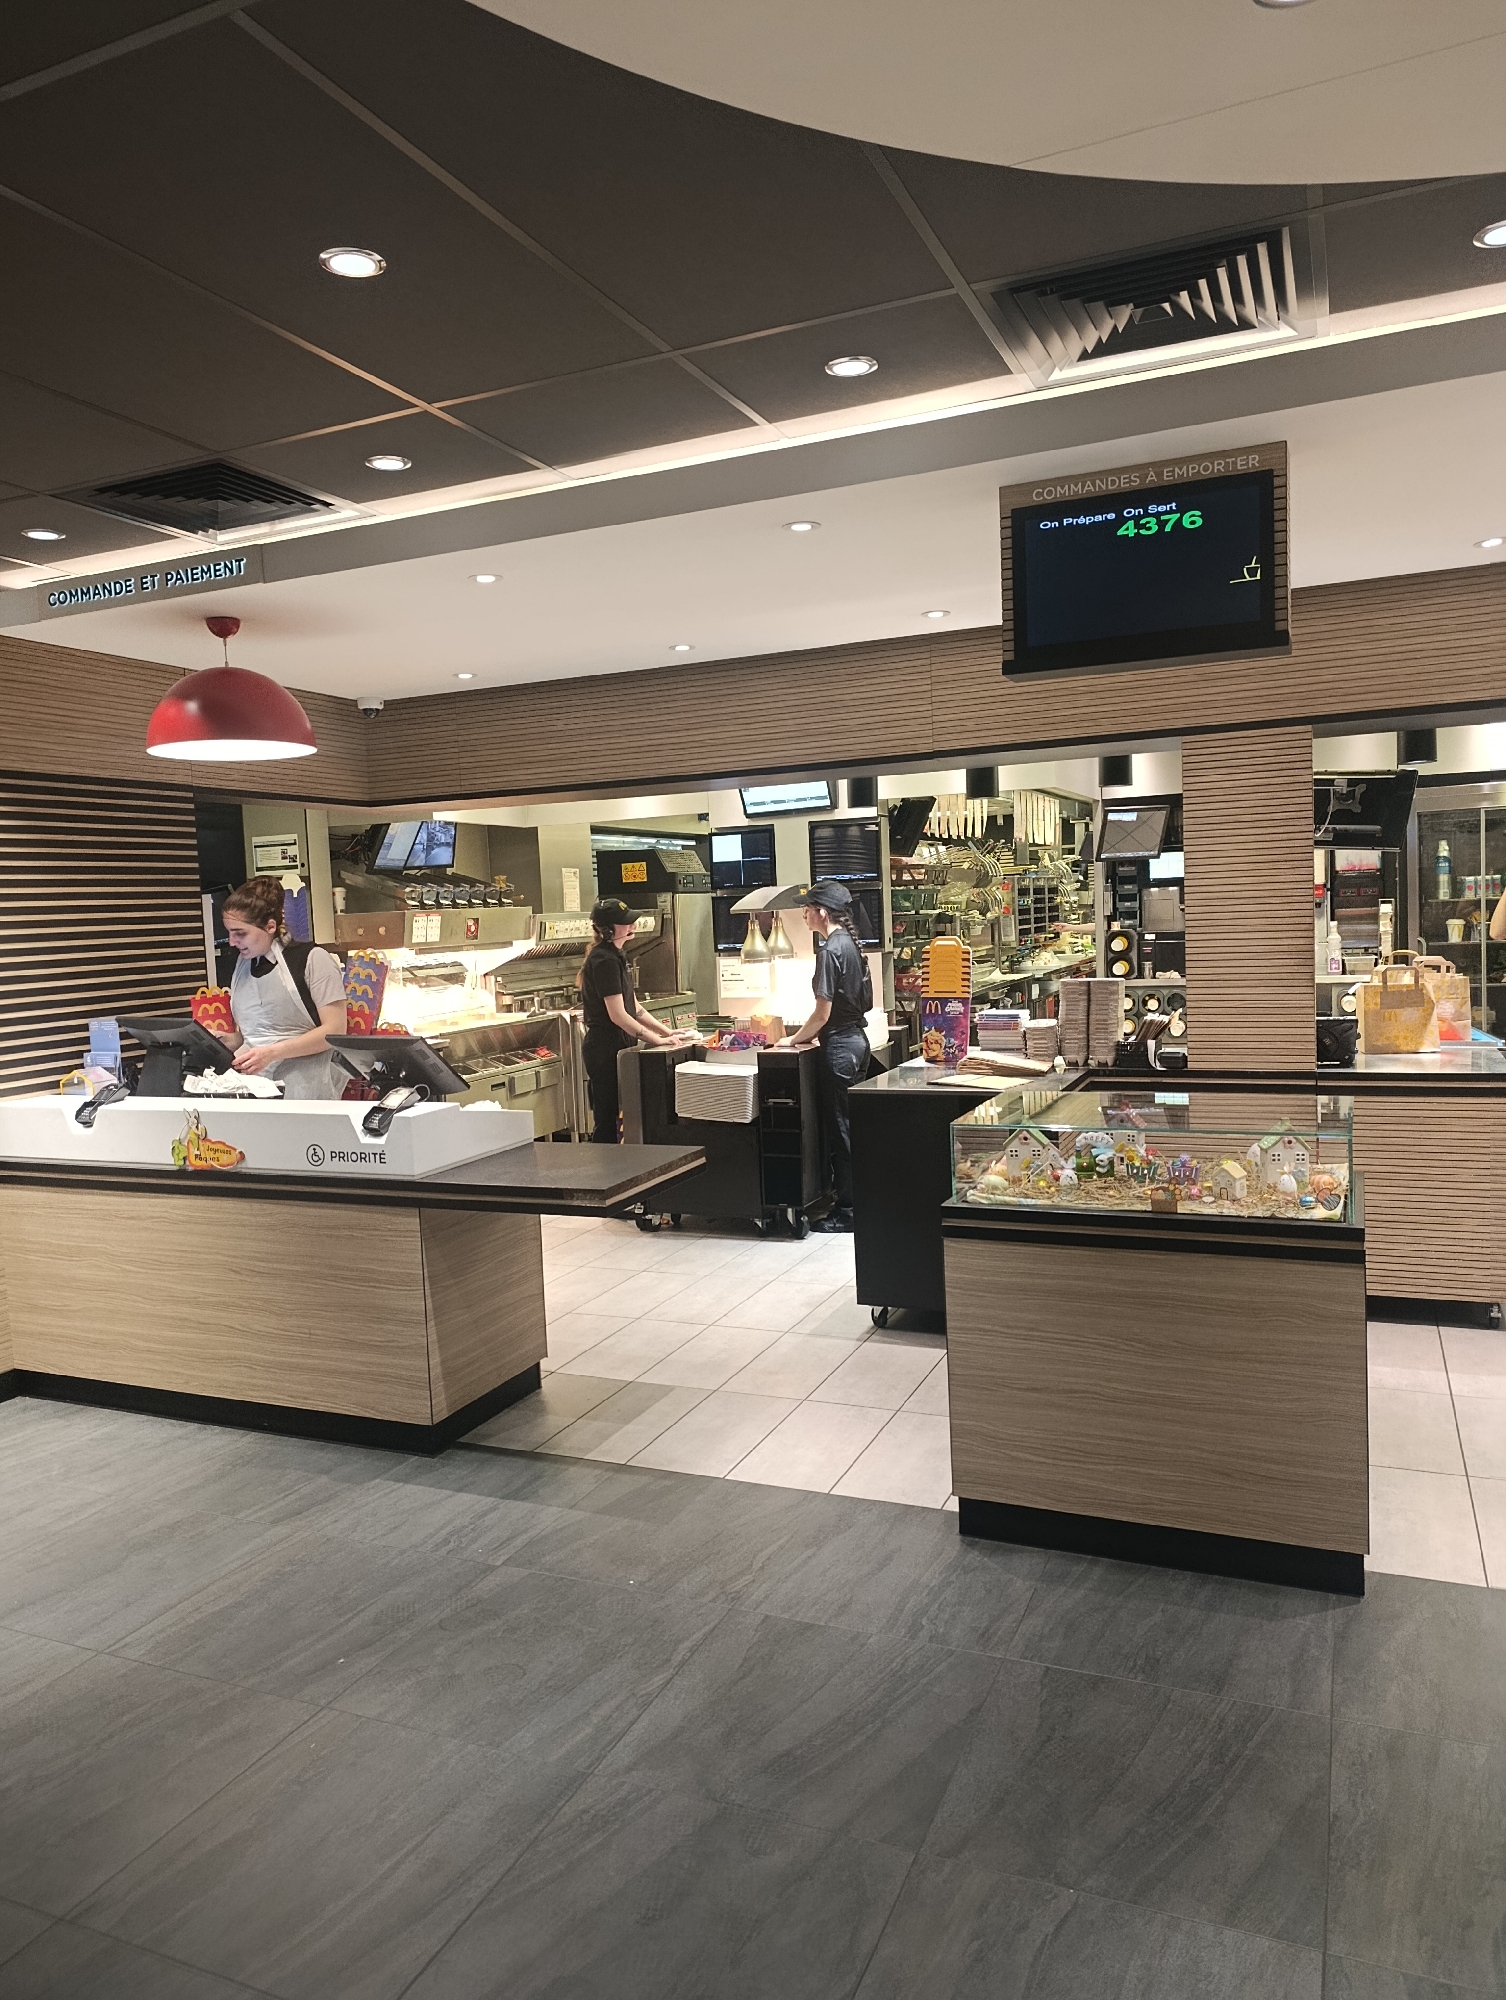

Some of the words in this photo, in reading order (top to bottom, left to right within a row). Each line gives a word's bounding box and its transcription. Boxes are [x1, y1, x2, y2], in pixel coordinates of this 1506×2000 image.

[1032, 473, 1140, 501] COMMANDES
[1145, 467, 1158, 484] À
[1163, 454, 1260, 481] EMPORTER
[1039, 521, 1059, 529] On
[1063, 511, 1116, 527] Prépare
[1123, 507, 1144, 517] On
[1148, 501, 1177, 514] Sert
[1116, 510, 1203, 538] 4376
[48, 578, 135, 607] COMMANDE
[140, 573, 159, 592] ET
[165, 557, 246, 587] PAIEMENT
[330, 1149, 387, 1165] PRIORITÉ
